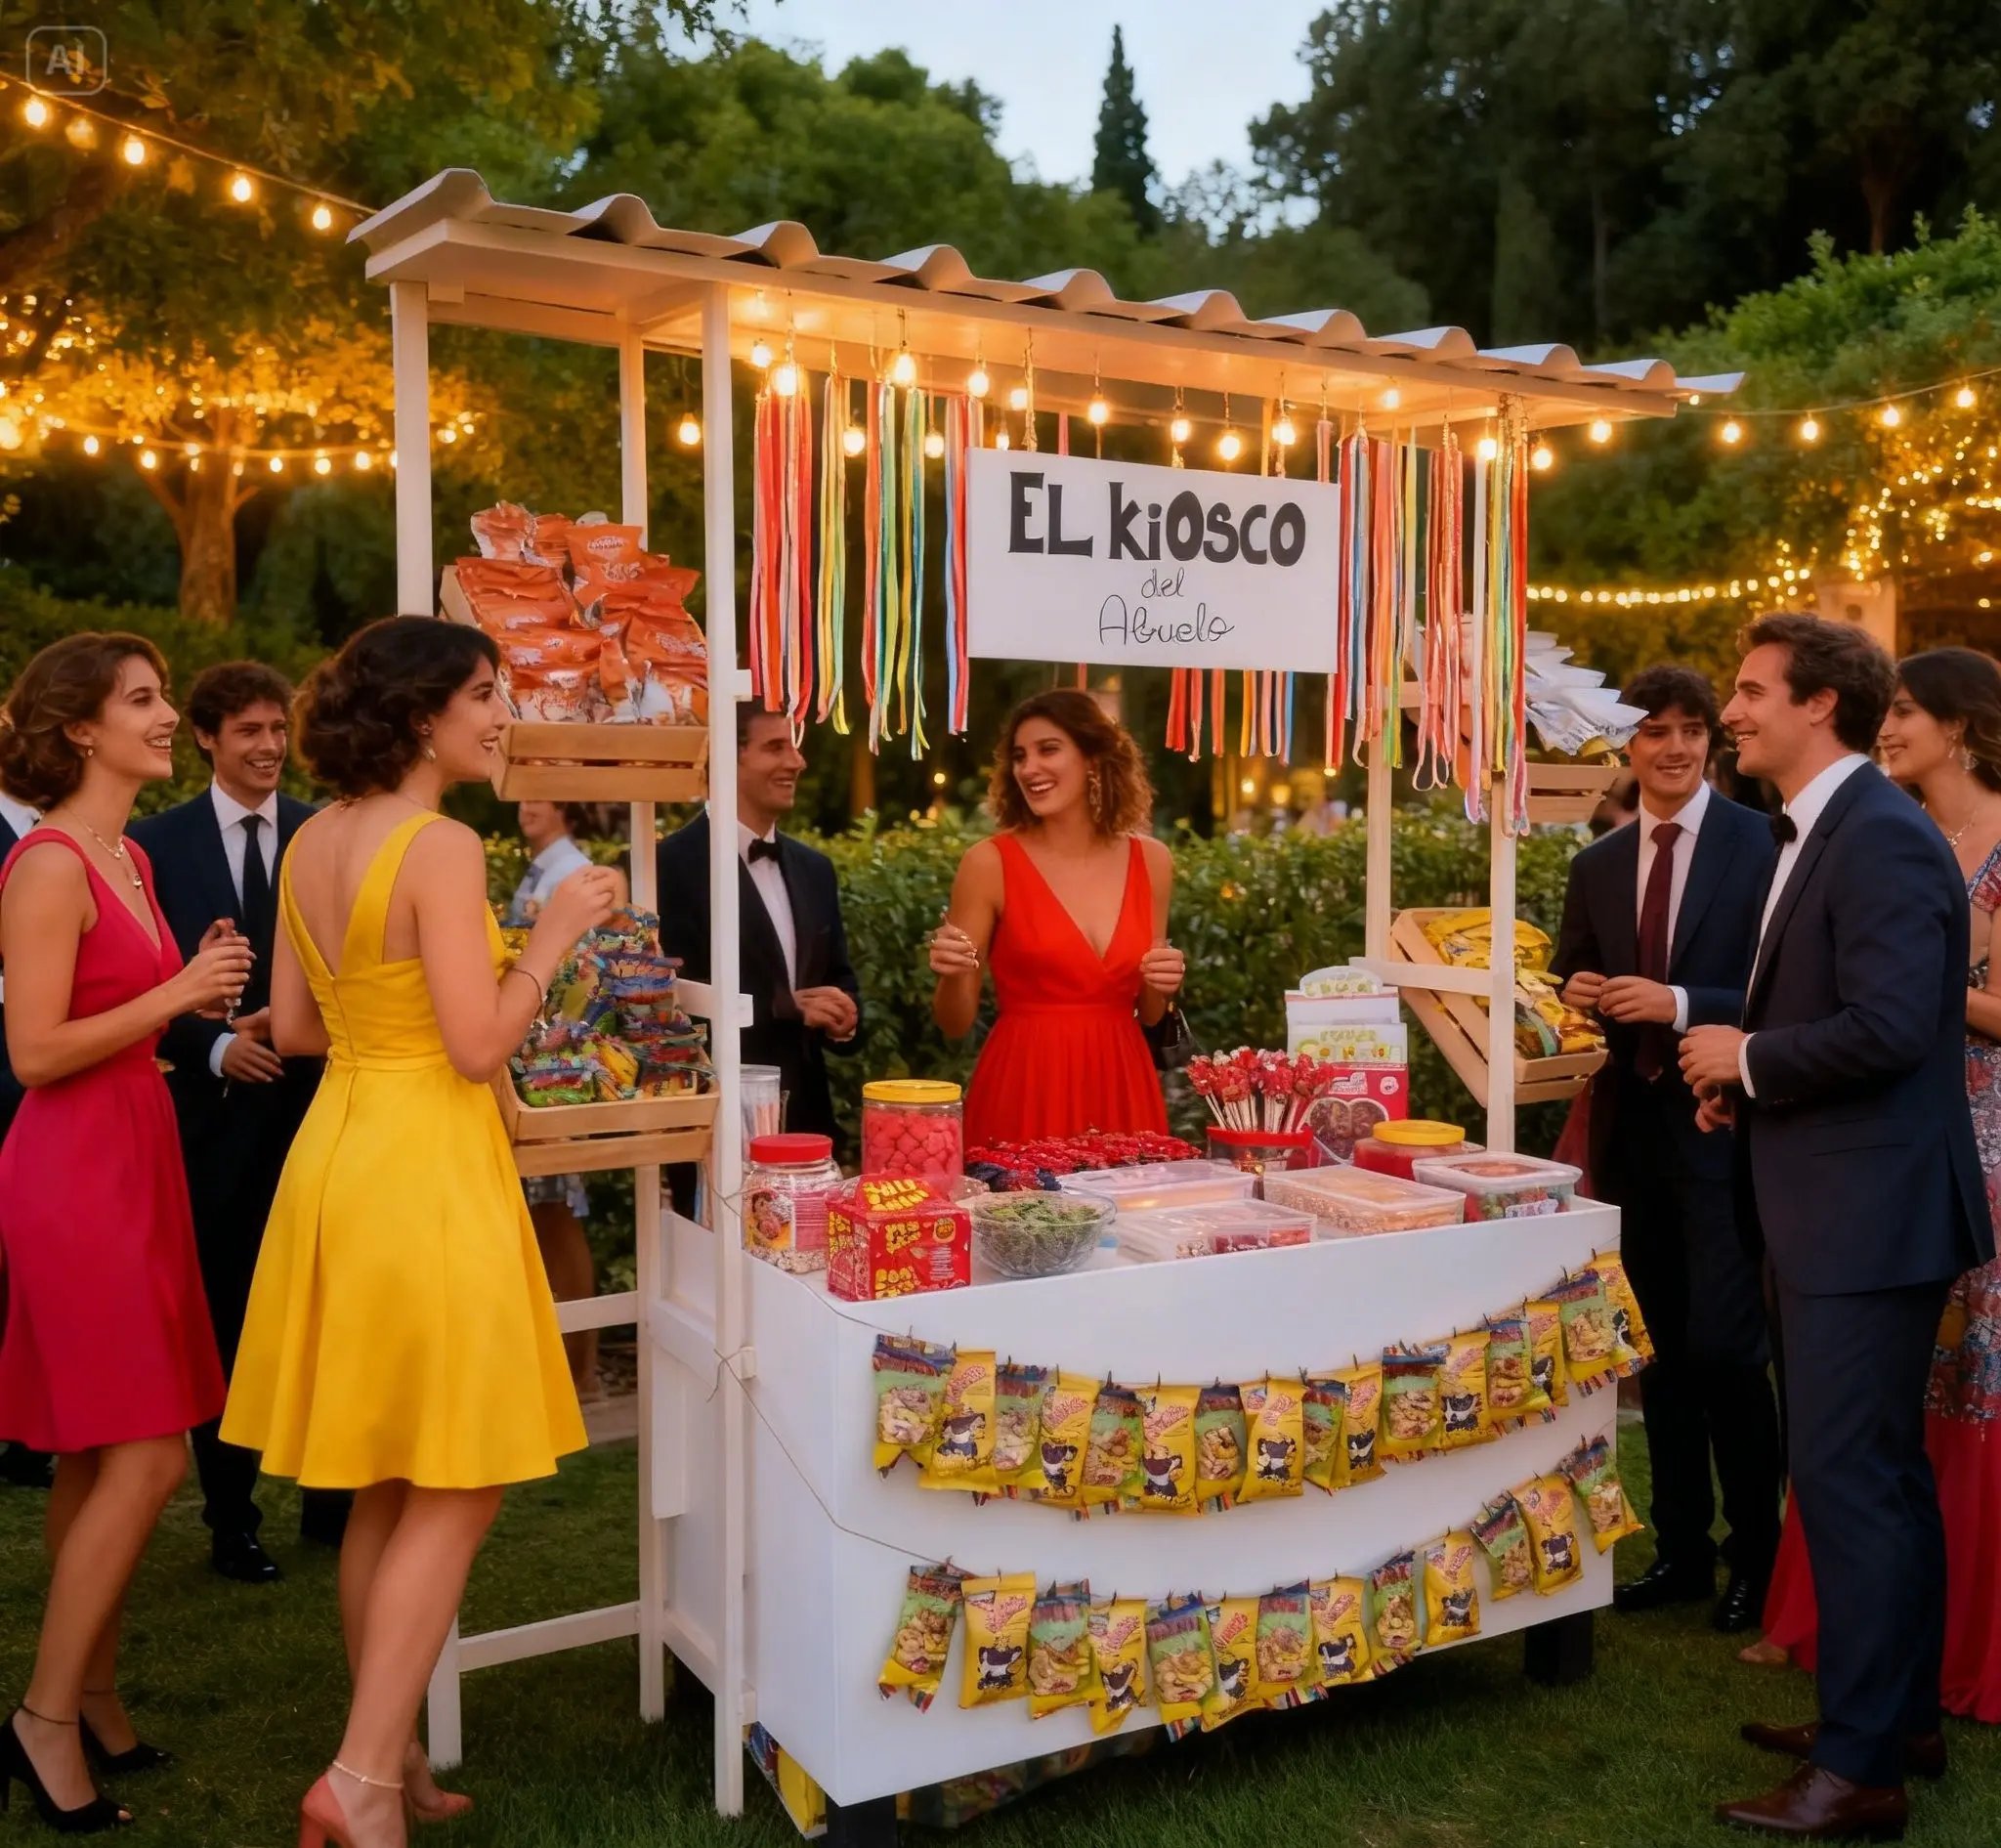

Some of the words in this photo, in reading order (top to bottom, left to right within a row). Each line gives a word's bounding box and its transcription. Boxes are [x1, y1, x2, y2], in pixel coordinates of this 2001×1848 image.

[1008, 471, 1093, 558] EL
[1141, 568, 1185, 598] del
[1099, 594, 1235, 645] Abuelo
